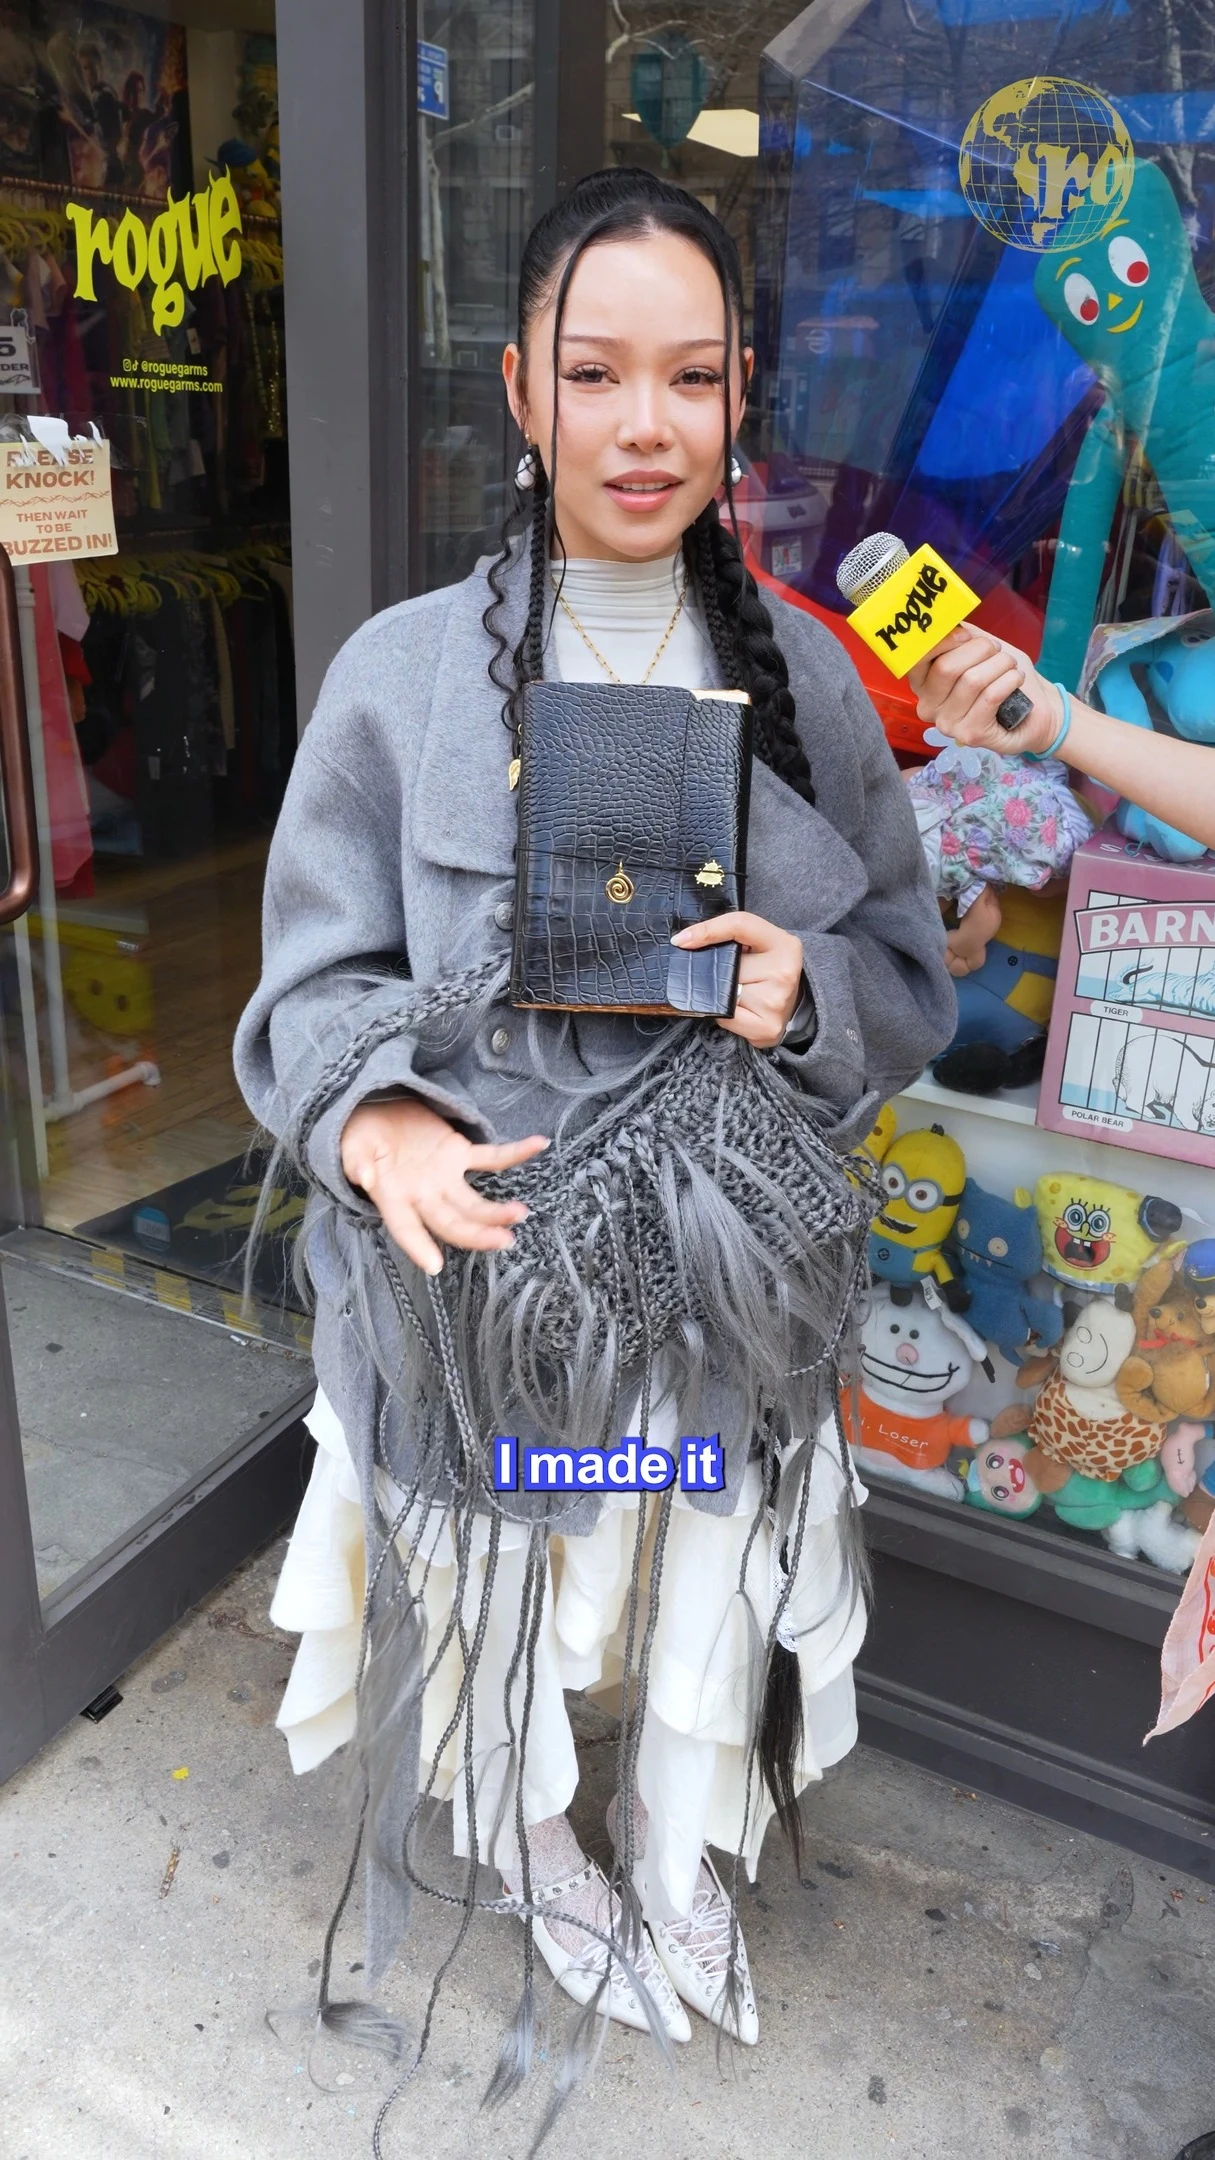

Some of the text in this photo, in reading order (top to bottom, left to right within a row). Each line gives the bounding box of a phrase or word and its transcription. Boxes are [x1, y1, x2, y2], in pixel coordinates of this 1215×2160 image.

[66, 164, 242, 336] rogue
[141, 361, 208, 378] @roguegarms
[110, 377, 223, 393] www.roguegarms.com
[6, 470, 95, 489] KNOCK!
[16, 509, 88, 522] THEN WAIT
[36, 522, 73, 534] TO BE
[1, 533, 112, 556] BUZZED IN!
[875, 562, 948, 651] rogue
[1103, 1006, 1129, 1017] TIGER
[1071, 1110, 1124, 1128] POLAR BEAR
[878, 1423, 929, 1449] Loser
